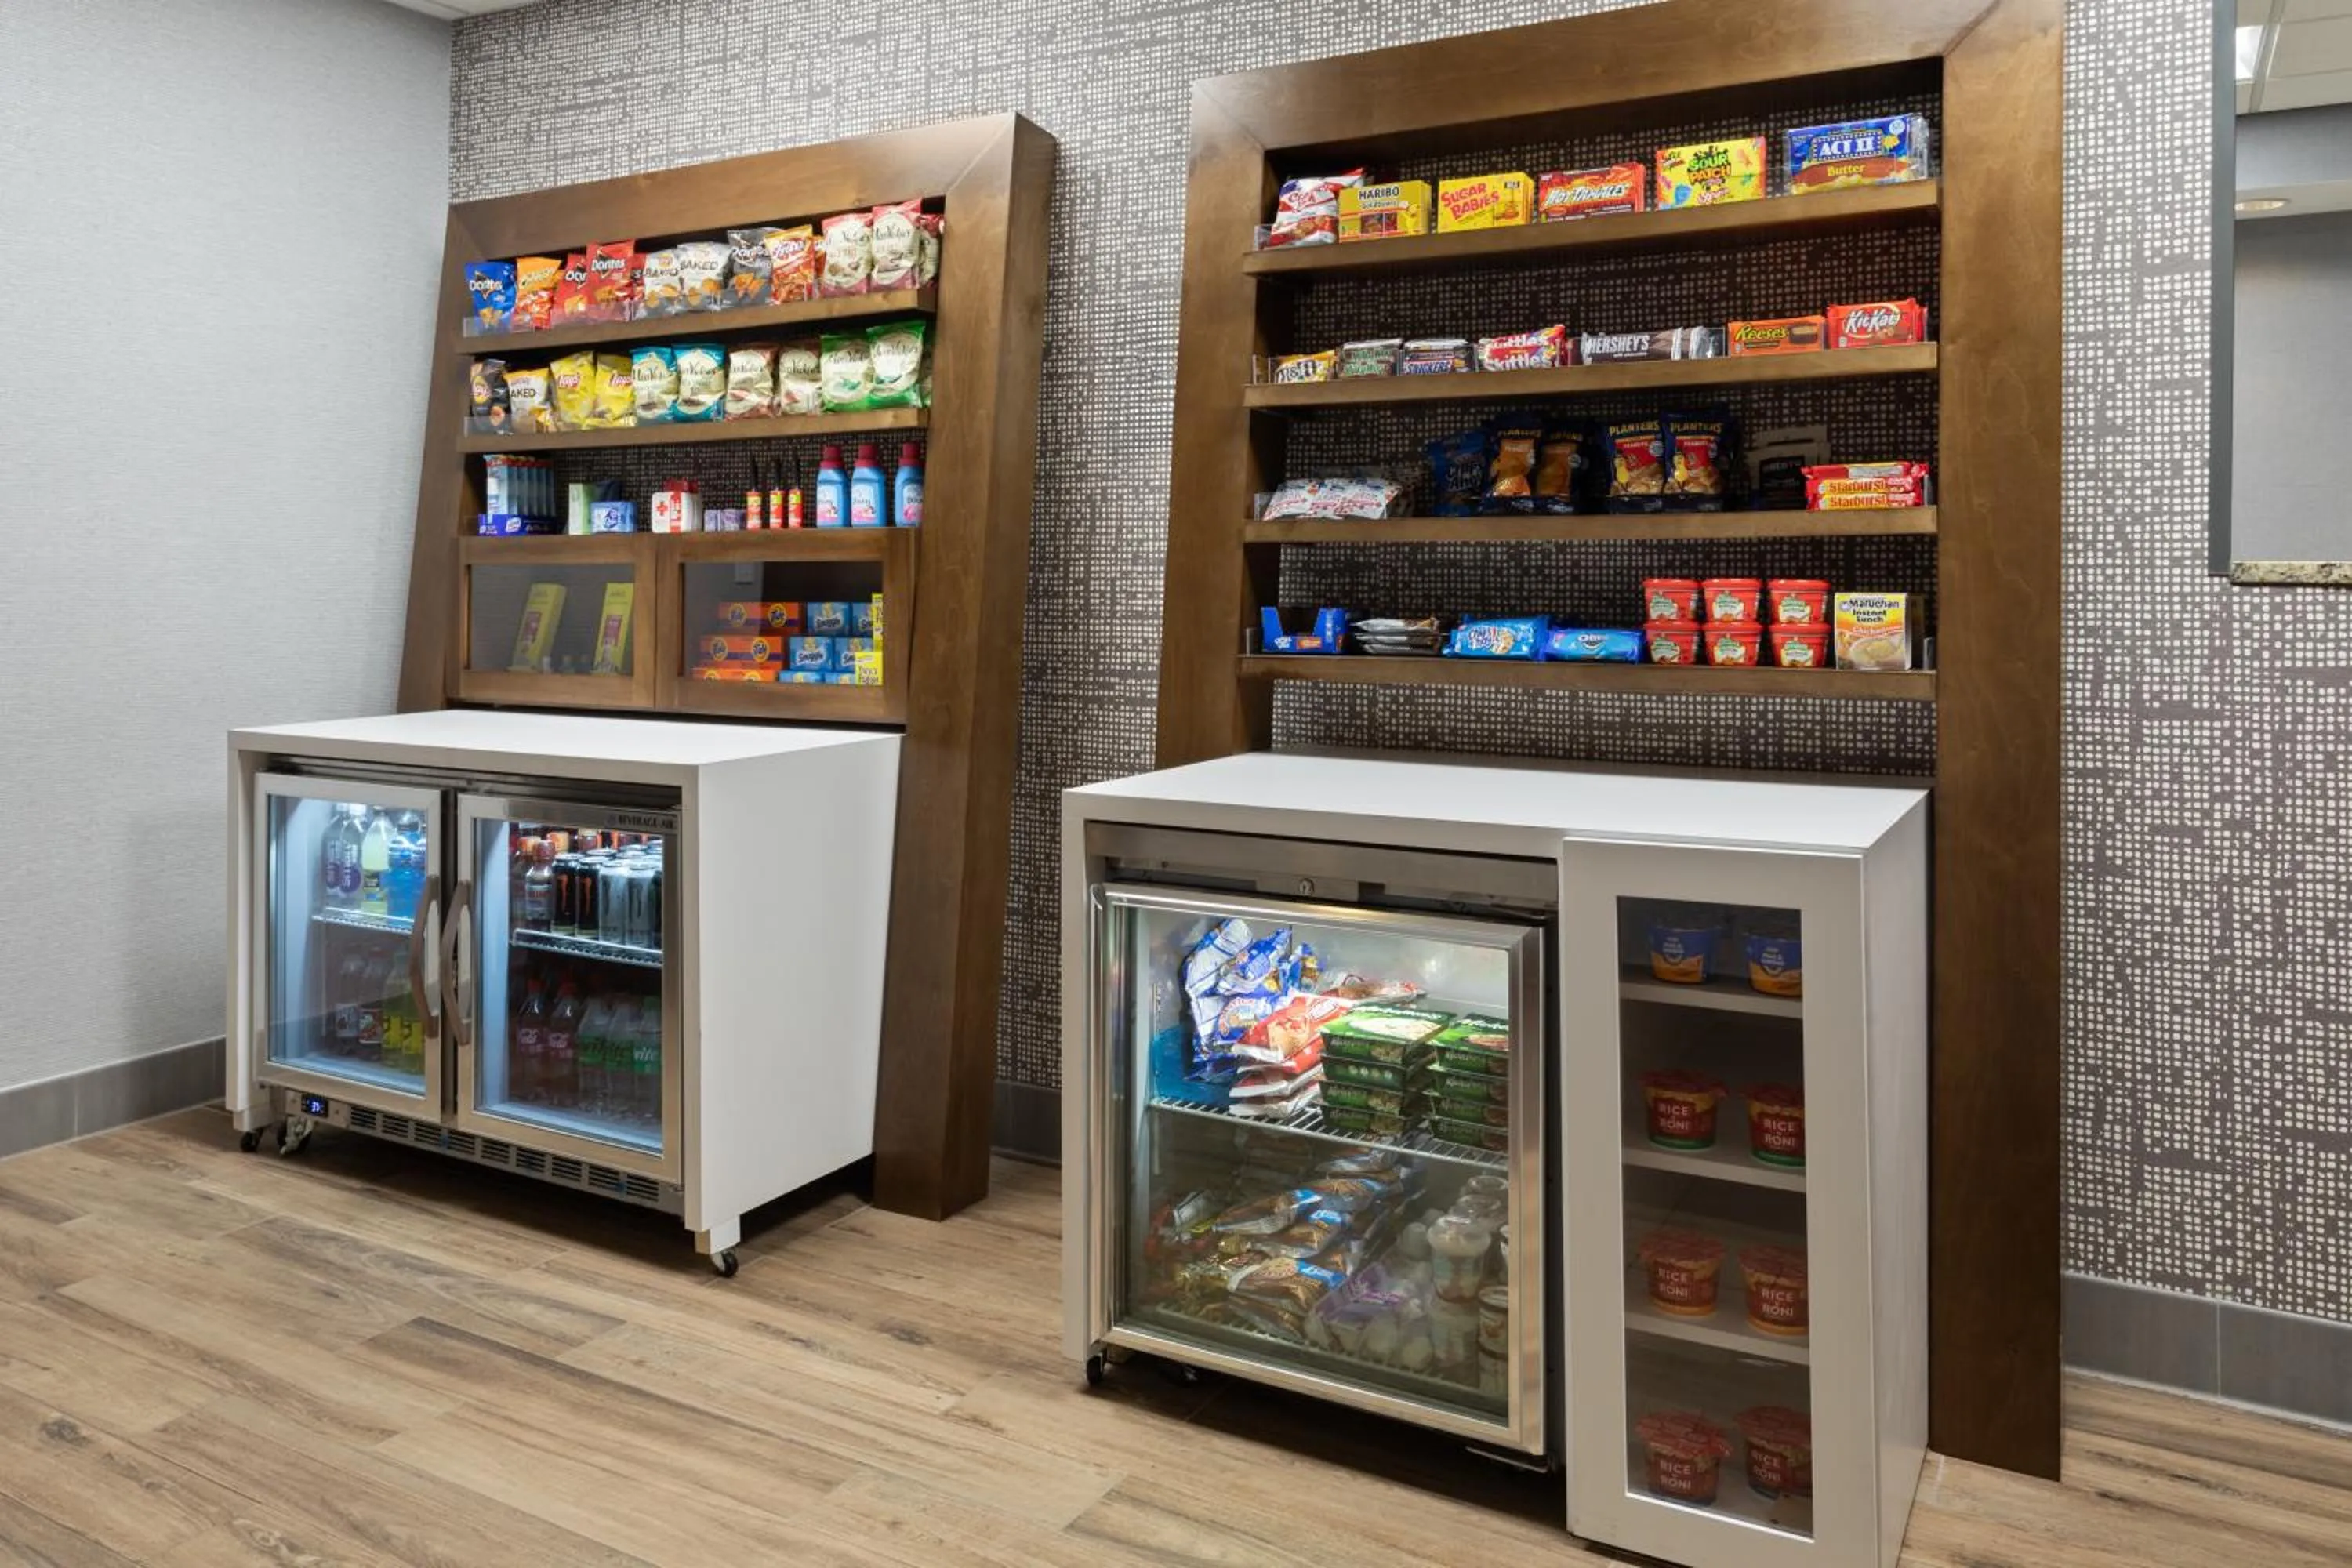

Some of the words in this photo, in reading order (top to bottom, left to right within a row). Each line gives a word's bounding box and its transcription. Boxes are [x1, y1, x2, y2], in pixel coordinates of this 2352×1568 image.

[1819, 140, 1853, 156] ACT
[1856, 136, 1875, 152] II
[1688, 152, 1729, 170] SOUR
[1689, 165, 1732, 183] PATCH
[1827, 163, 1866, 176] Butter
[1358, 186, 1400, 201] HARIBO
[1440, 182, 1487, 207] SUGAR
[1450, 191, 1501, 220] BABIES
[1586, 335, 1651, 354] HERSHEY'S
[510, 388, 537, 398] AKED
[1608, 421, 1661, 437] PLANTERS
[1828, 480, 1886, 493] Starburst
[1829, 494, 1887, 508] Starburst
[1658, 1102, 1689, 1116] RICE
